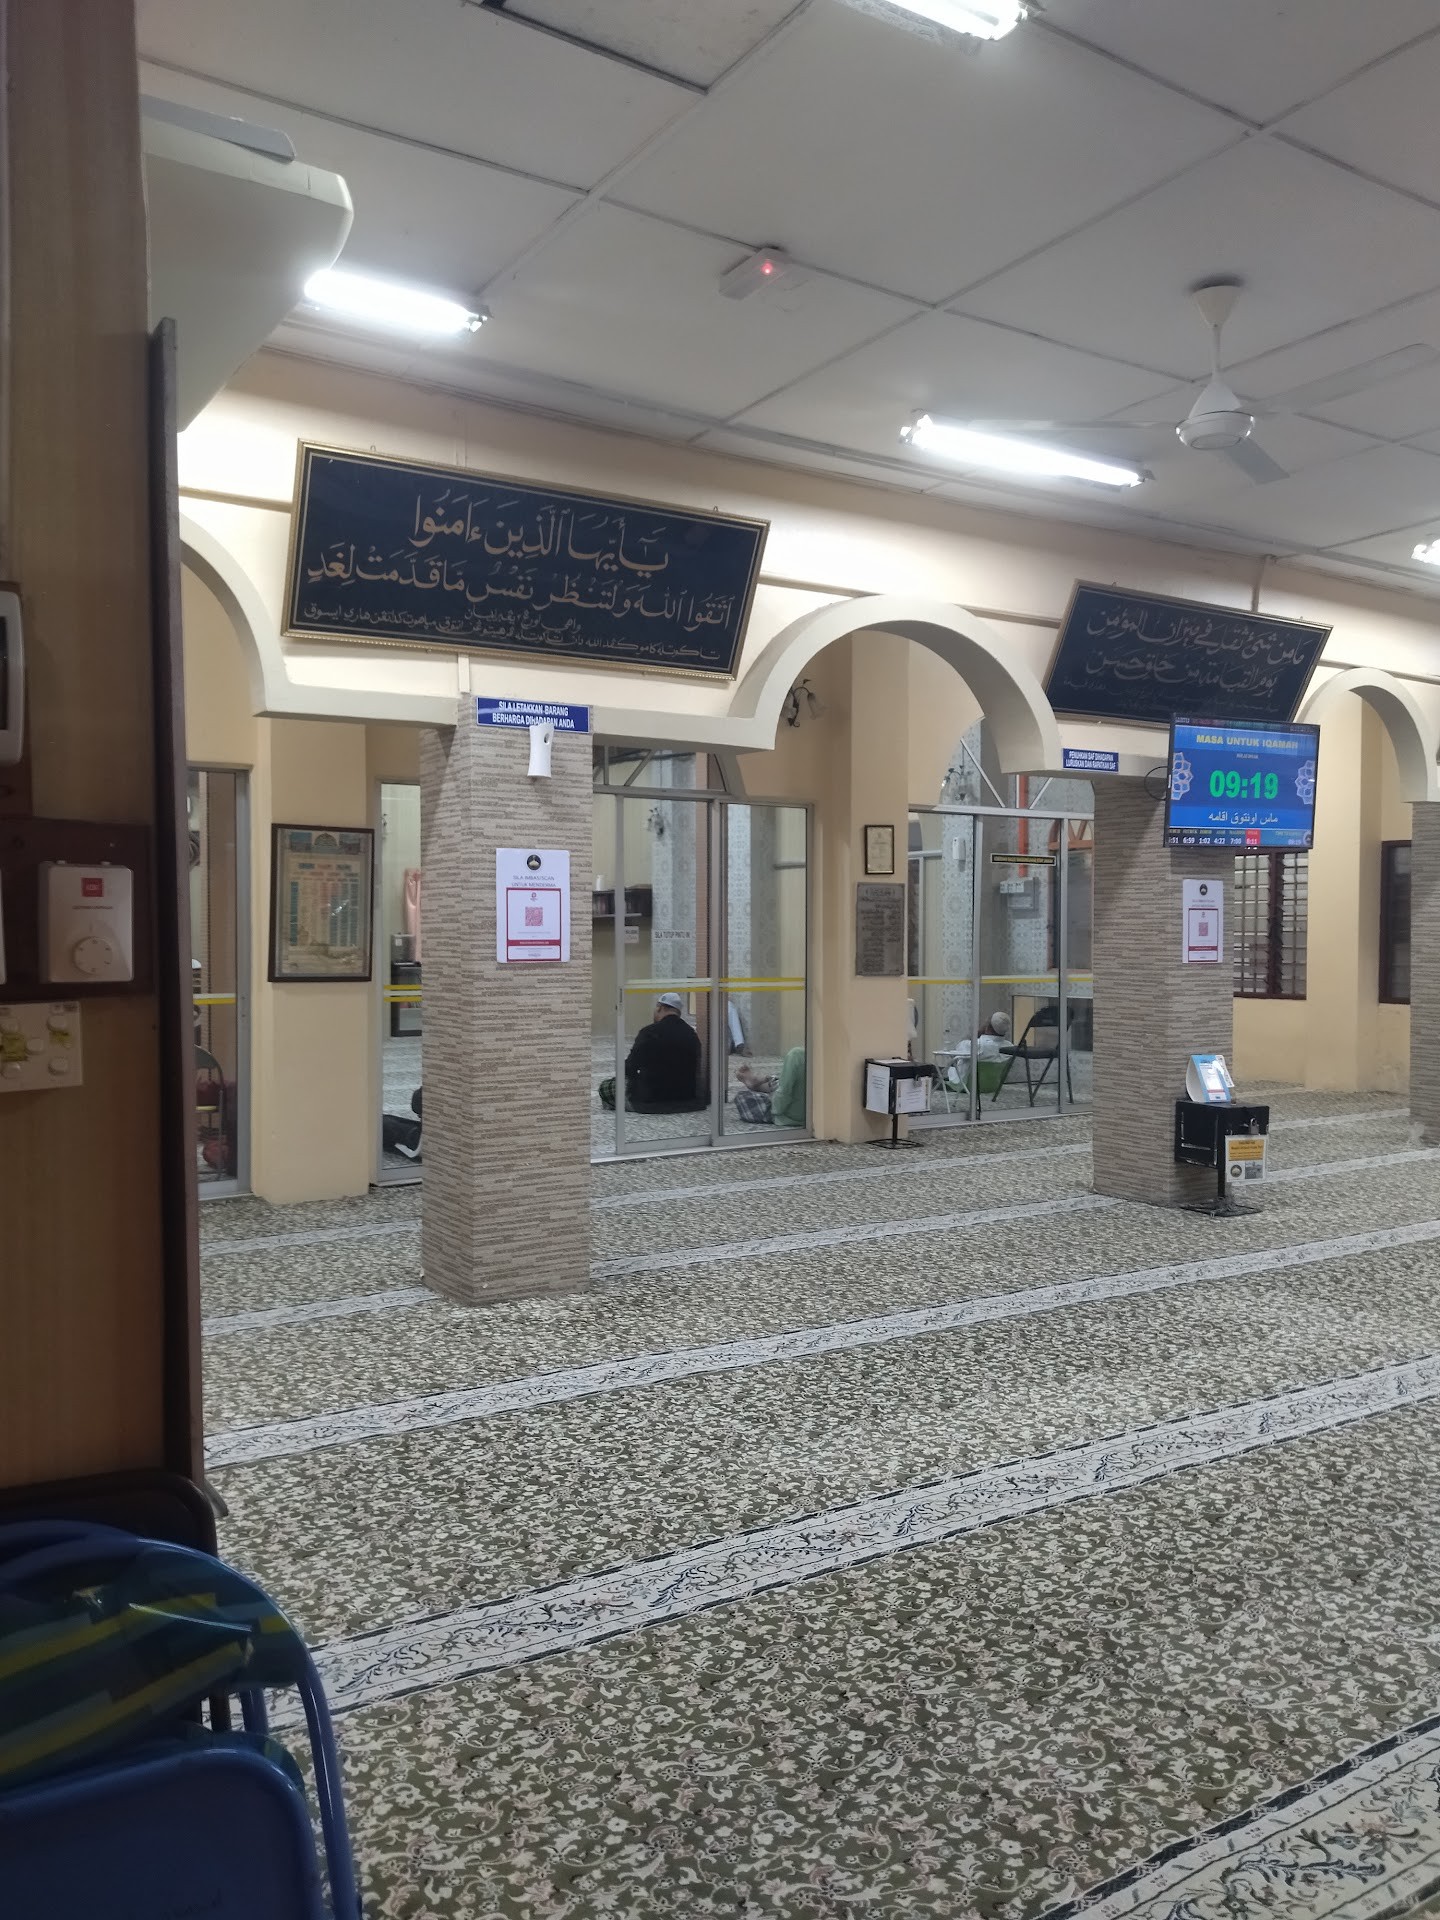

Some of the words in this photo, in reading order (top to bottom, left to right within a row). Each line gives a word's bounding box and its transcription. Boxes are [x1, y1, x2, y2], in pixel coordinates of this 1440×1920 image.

[499, 701, 512, 710] SILA
[513, 702, 543, 715] LETAKKAN
[545, 705, 569, 716] BARANG
[492, 713, 525, 725] BERHARGA
[559, 717, 575, 729] ANDA
[1196, 734, 1223, 744] MASA
[1226, 736, 1259, 747] UNTUK
[1262, 739, 1298, 749] IQAMAH
[1209, 769, 1279, 800] 09:19
